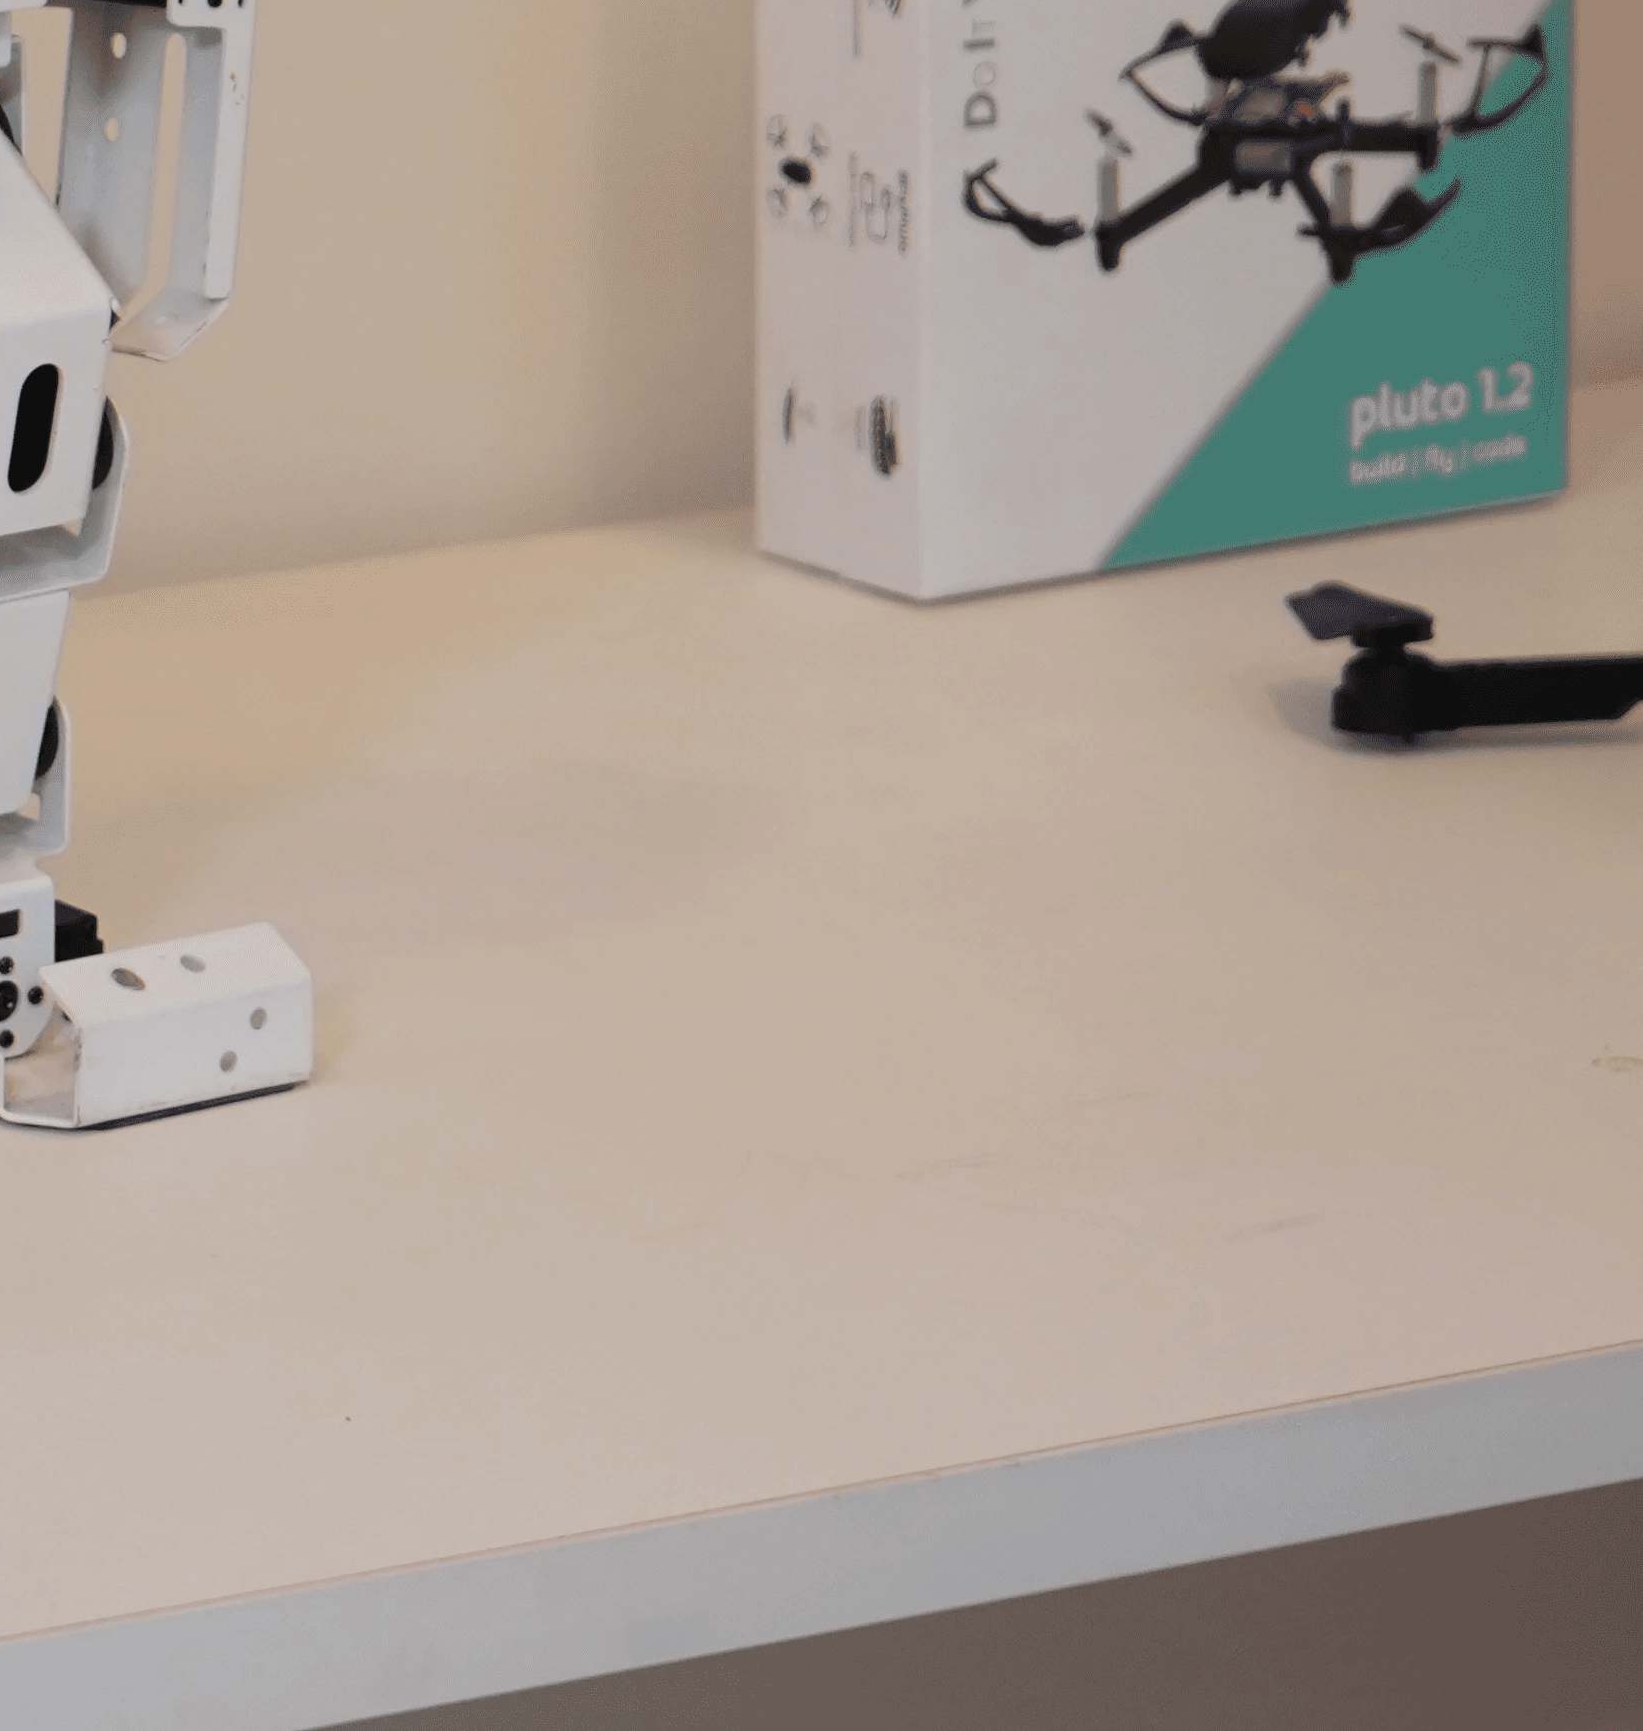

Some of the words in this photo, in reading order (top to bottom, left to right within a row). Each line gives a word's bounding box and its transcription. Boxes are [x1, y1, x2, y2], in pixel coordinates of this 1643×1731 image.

[1351, 377, 1469, 449] pluto
[1351, 453, 1408, 484] build
[1426, 443, 1456, 474] fly
